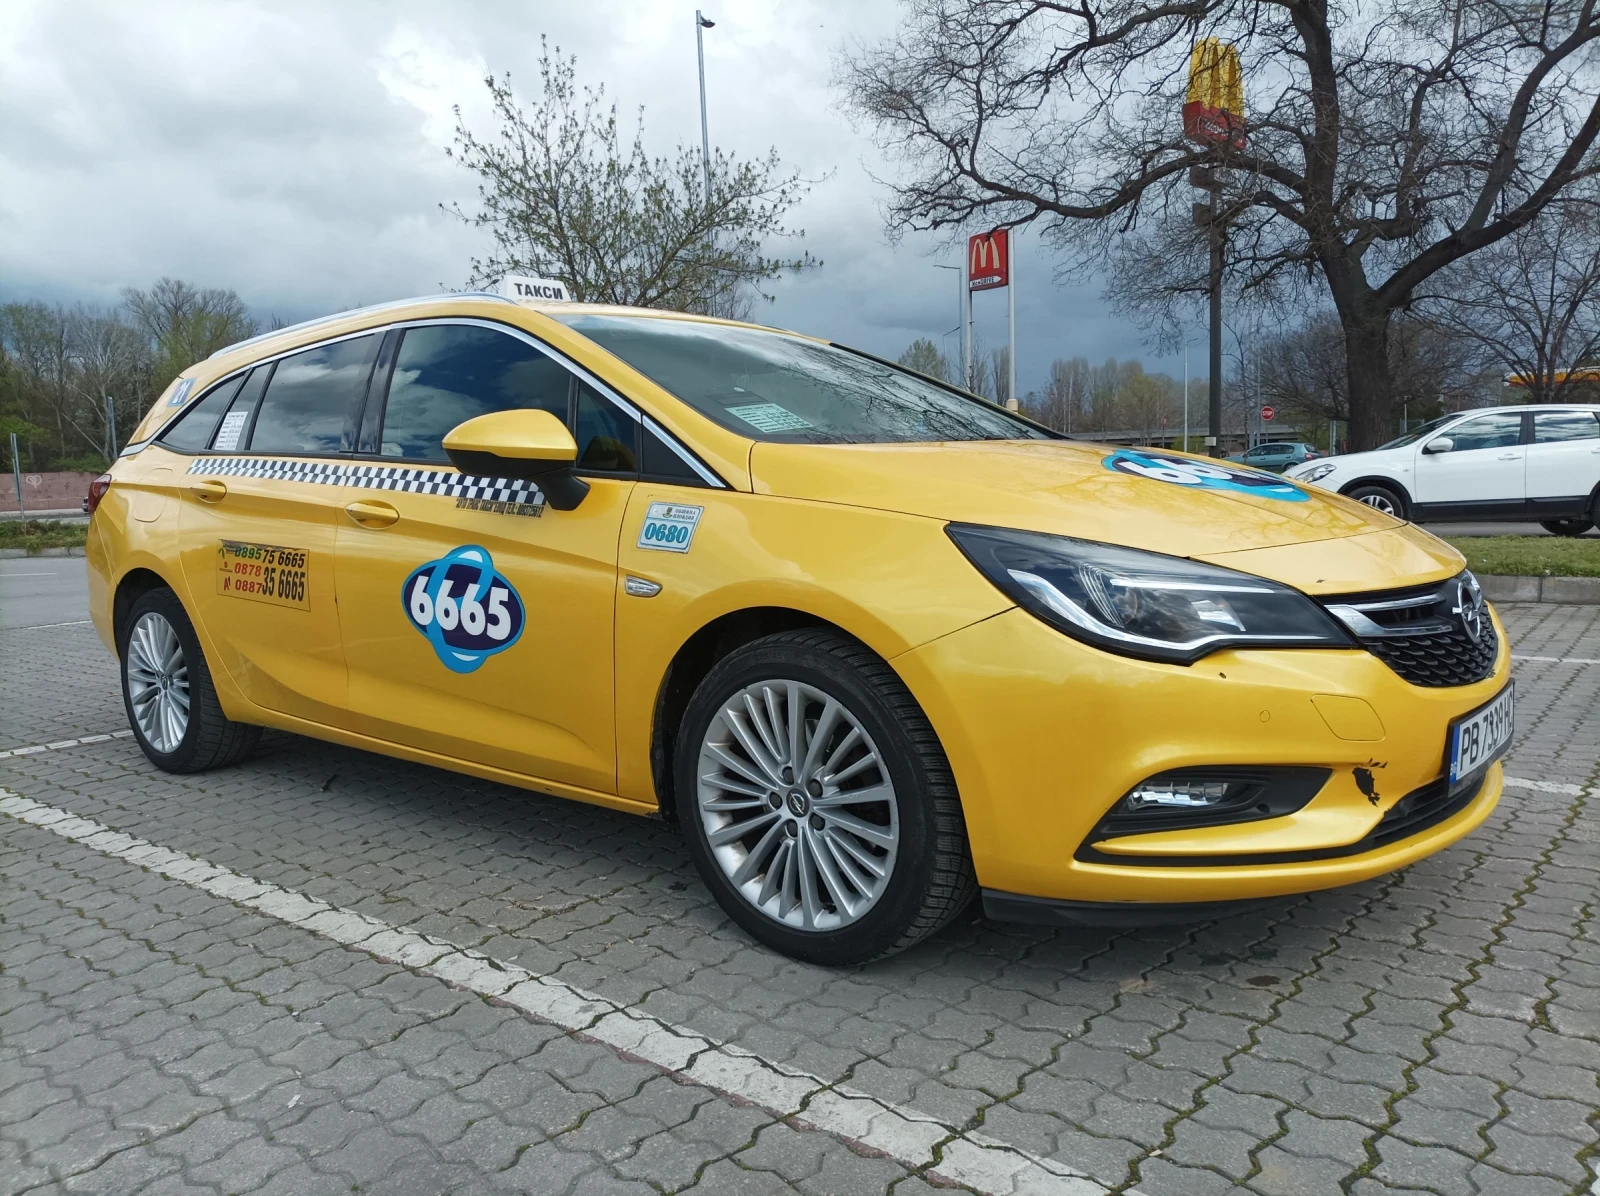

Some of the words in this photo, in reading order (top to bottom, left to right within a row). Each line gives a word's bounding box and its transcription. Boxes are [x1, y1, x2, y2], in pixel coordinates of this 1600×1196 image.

[513, 282, 564, 300] ТАКСИ
[172, 380, 191, 404] 21
[674, 508, 697, 516] ОБЩИНА
[644, 522, 689, 544] 0680
[262, 549, 276, 565] 75
[277, 551, 306, 569] 6665
[234, 562, 262, 577] 0878
[262, 566, 276, 597] 35
[278, 568, 306, 602] 6665
[235, 579, 262, 594] 0887
[410, 575, 512, 640] 6665
[1460, 721, 1480, 772] PB
[1480, 700, 1504, 759] 7339
